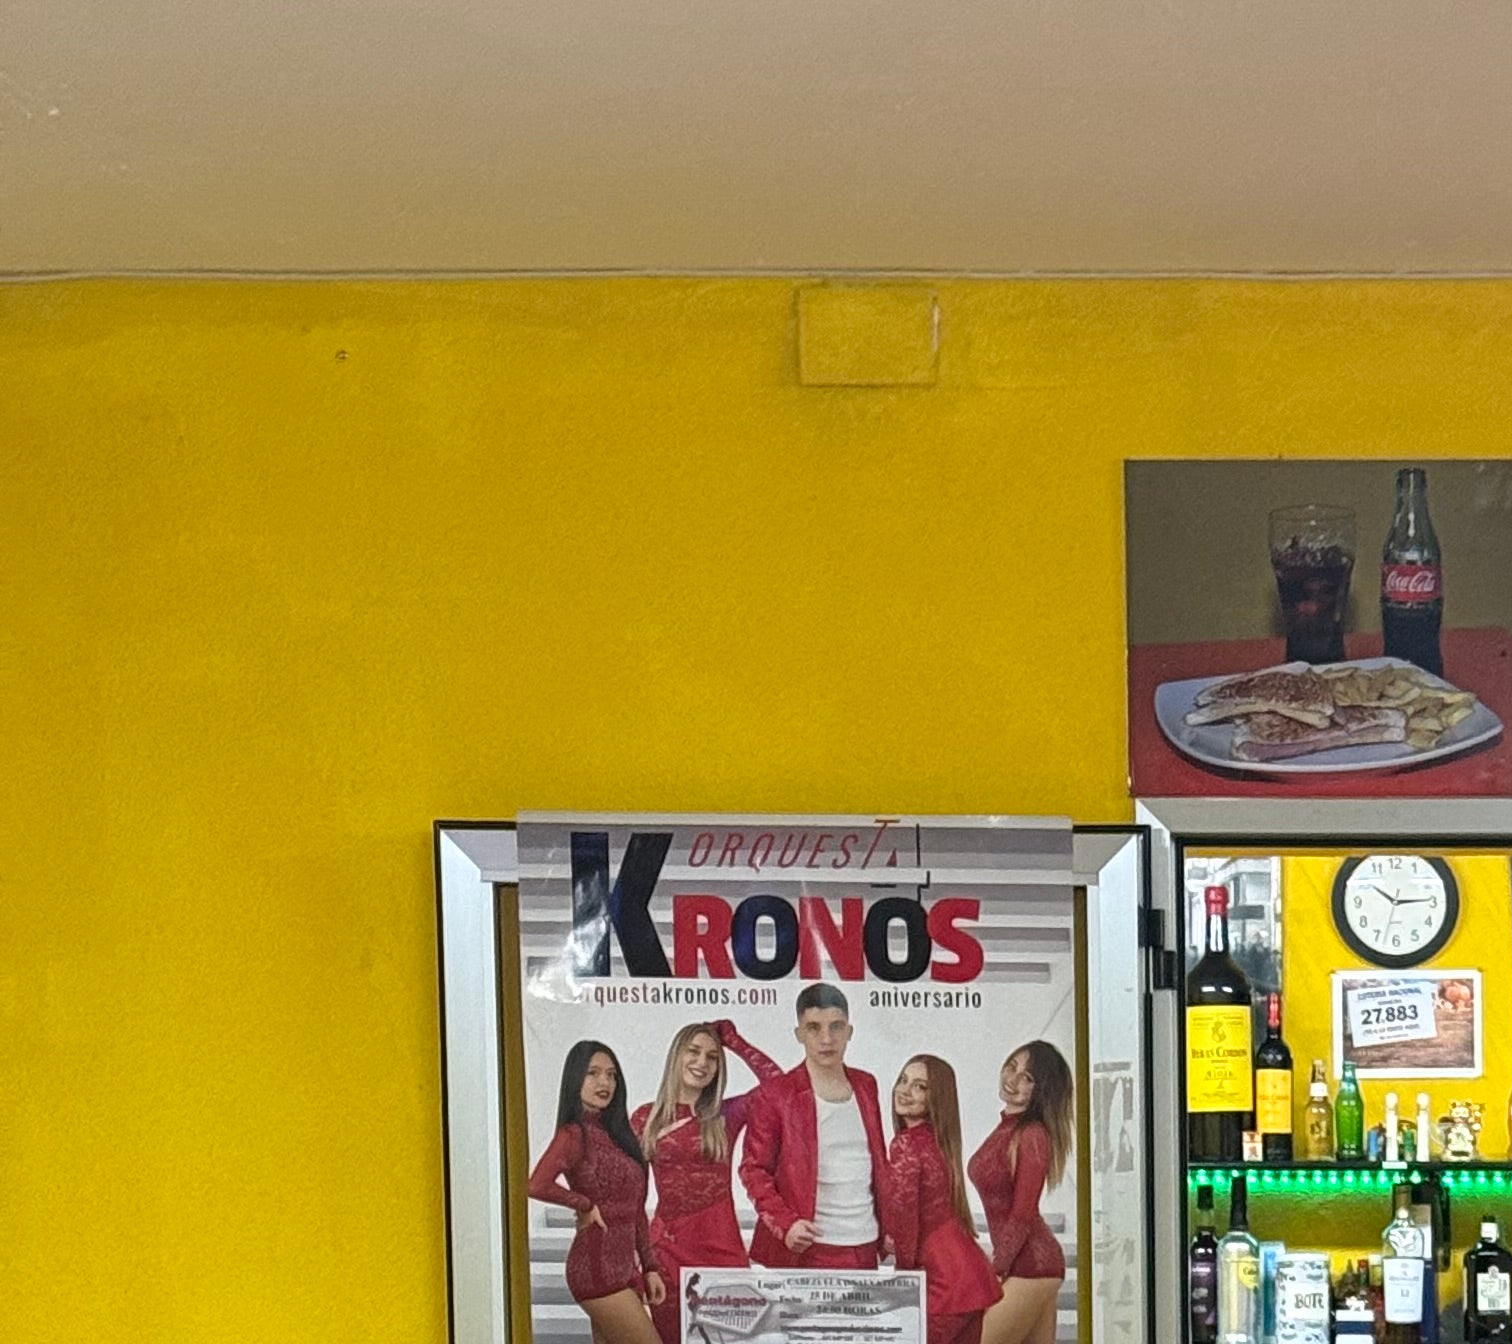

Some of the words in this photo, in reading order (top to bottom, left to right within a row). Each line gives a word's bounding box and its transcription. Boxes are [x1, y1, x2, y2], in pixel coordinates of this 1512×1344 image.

[1371, 862, 1383, 875] 11
[1388, 857, 1402, 870] 12
[1411, 862, 1418, 874] 1
[570, 831, 985, 983] KRONOS
[1353, 896, 1363, 909] 9
[1427, 895, 1438, 909] 3
[1359, 915, 1368, 928] 8
[1424, 915, 1433, 928] 4
[1373, 929, 1381, 942] 7
[1391, 934, 1401, 947] 6
[1411, 929, 1420, 942] 5
[869, 987, 982, 1009] aniversario
